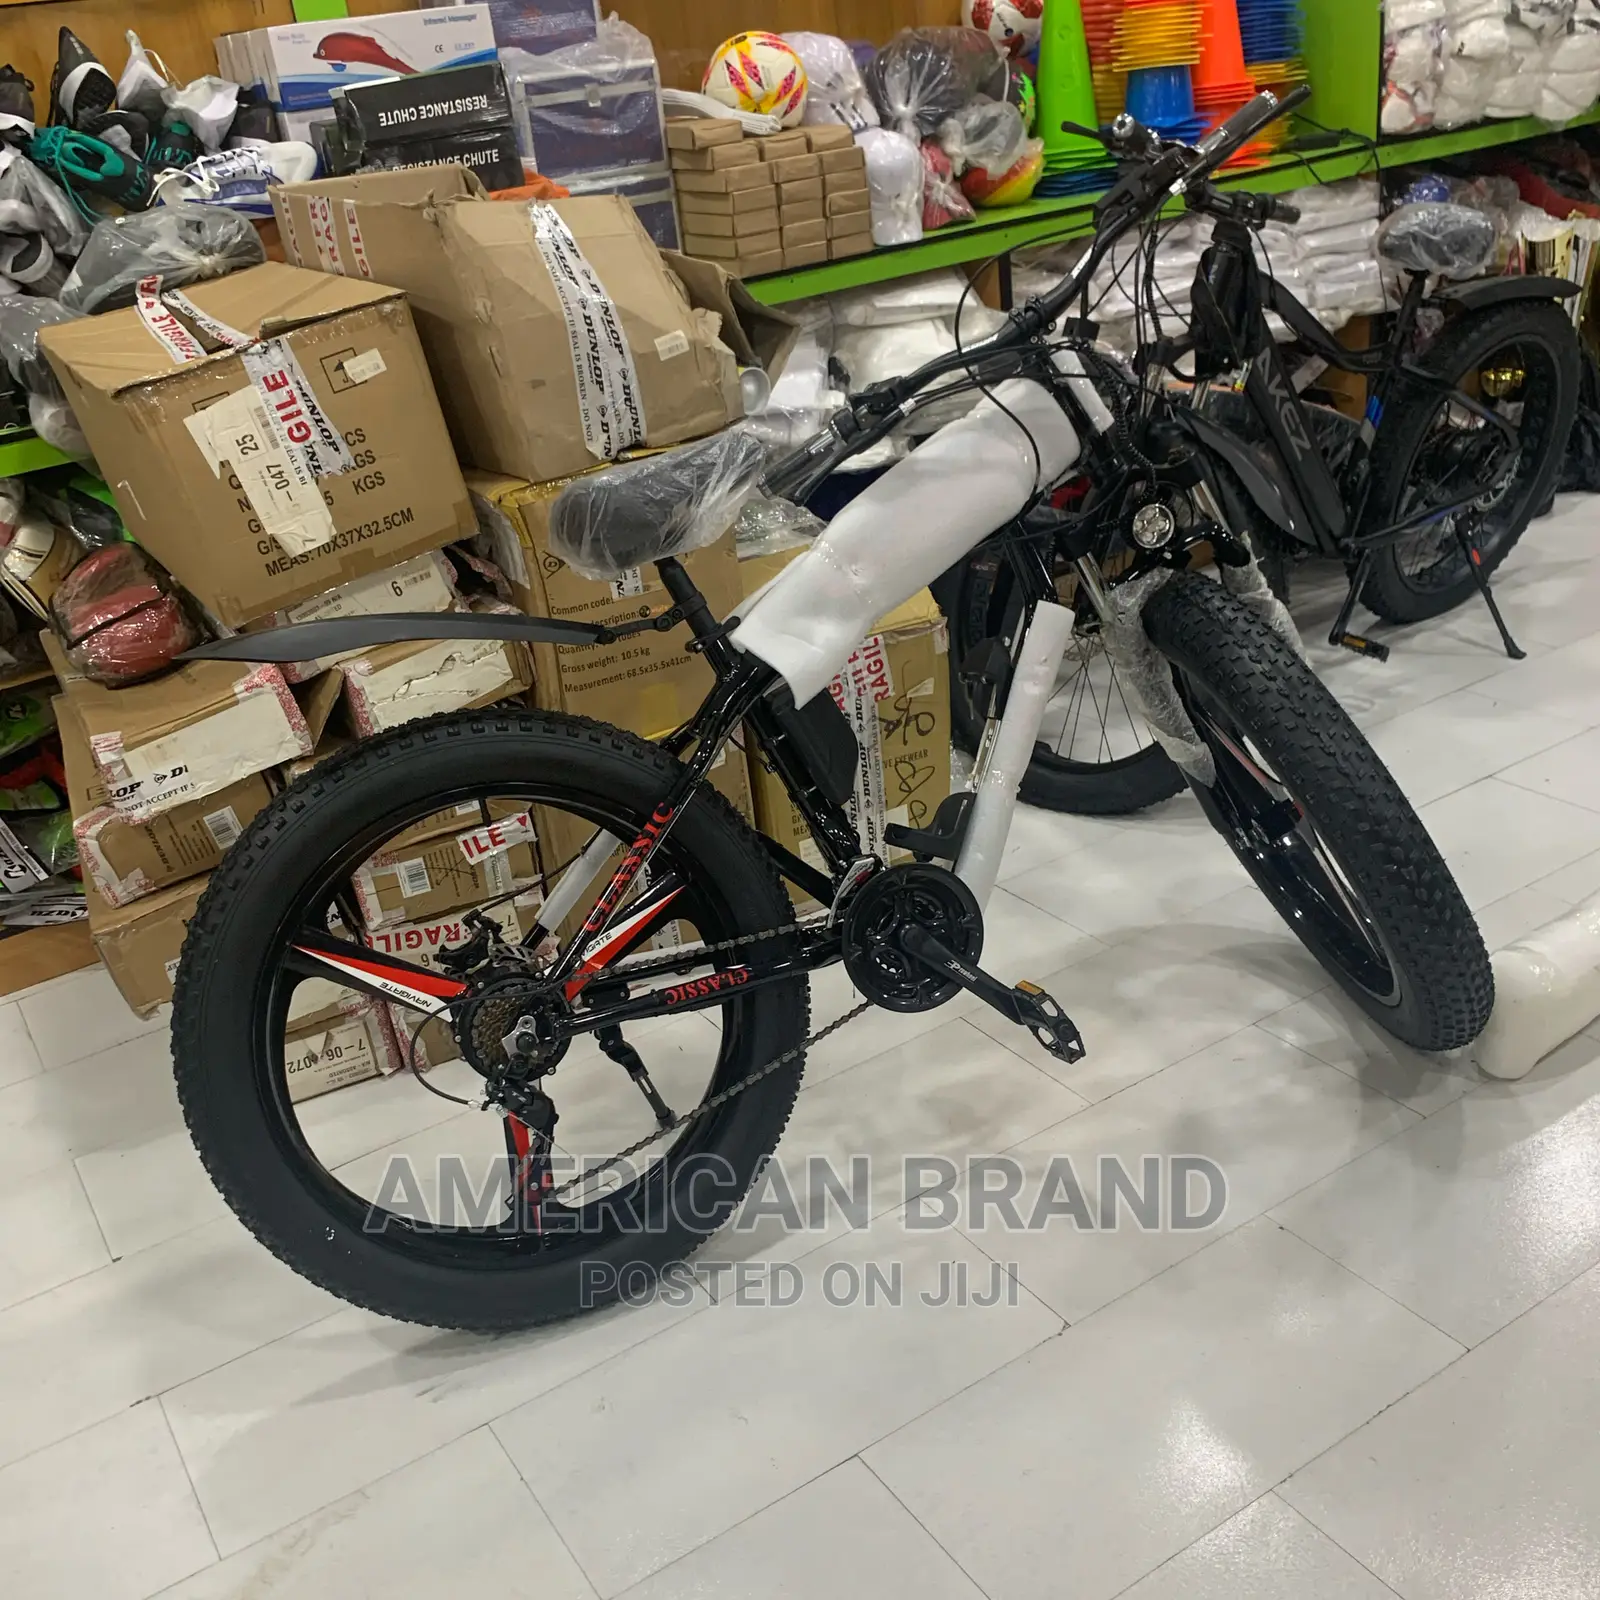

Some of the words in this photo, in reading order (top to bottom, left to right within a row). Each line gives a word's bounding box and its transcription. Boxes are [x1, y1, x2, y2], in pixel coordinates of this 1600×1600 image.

[418, 94, 488, 114] RESISTANCE
[378, 110, 418, 127] CHUTE
[464, 148, 500, 168] CHUTE
[570, 326, 580, 351] SEAL
[574, 354, 582, 362] IS
[582, 314, 605, 396] DUNLOP
[576, 364, 588, 400] BROKEN
[262, 370, 312, 444] GILE
[582, 408, 590, 422] DO
[586, 423, 594, 442] NOT
[235, 434, 259, 456] 25
[283, 444, 299, 466] SEAL
[352, 470, 386, 495] KGS
[265, 550, 315, 577] MEAS:
[316, 507, 415, 558] 70X37X32.5CM
[390, 580, 403, 598] 6
[550, 602, 589, 616] Common
[590, 597, 616, 609] code:
[561, 664, 586, 674] Gross
[586, 655, 618, 670] weight:
[621, 648, 640, 661] 10.5
[640, 646, 650, 657] kg
[564, 672, 626, 693] Measurement:
[626, 654, 693, 678] 68.5x35.5x41cm
[859, 741, 872, 797] DUNLOP
[124, 802, 144, 813] NOT
[145, 790, 178, 806] ACCEPT
[462, 826, 507, 860] ILE
[582, 802, 674, 932] CLASSIC
[420, 953, 430, 968] 6
[379, 980, 432, 1008] NAVIGATE
[664, 968, 749, 1005] CLASSIC
[287, 1056, 312, 1074] 072
